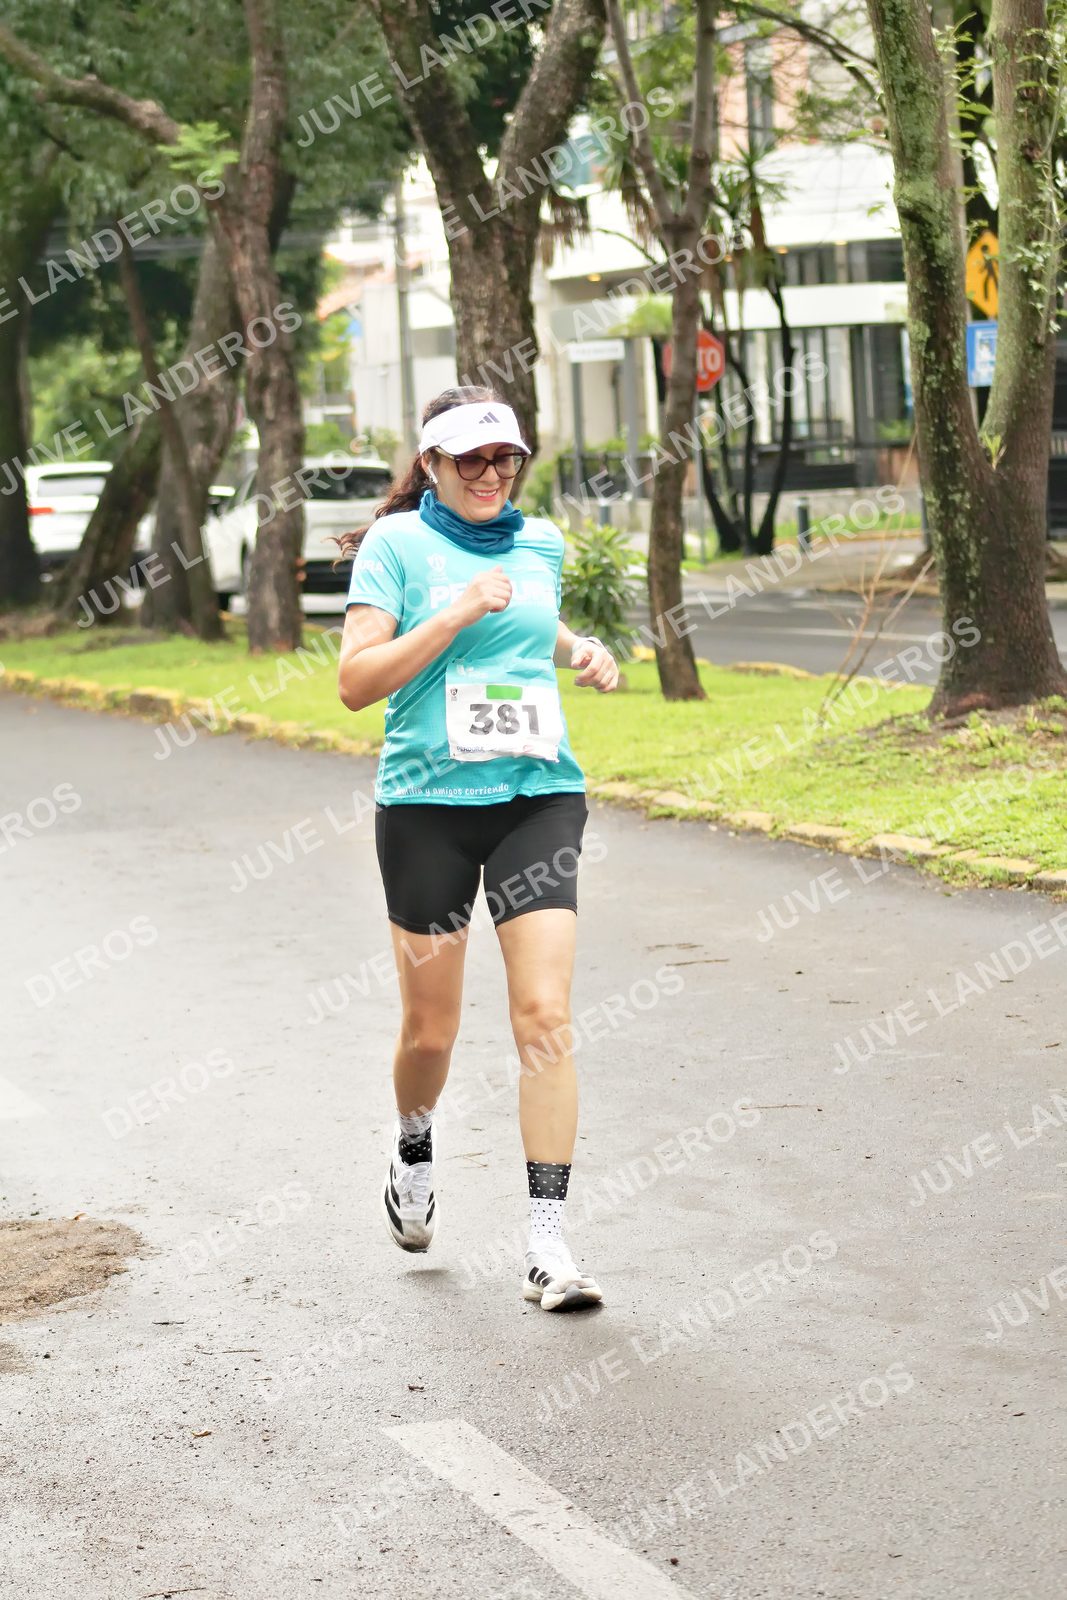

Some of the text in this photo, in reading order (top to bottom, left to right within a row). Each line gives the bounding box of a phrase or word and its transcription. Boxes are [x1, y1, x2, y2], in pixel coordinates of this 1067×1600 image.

[696, 347, 721, 372] TO
[469, 704, 540, 735] 381
[432, 786, 461, 797] amigos
[465, 783, 509, 795] corriendo
